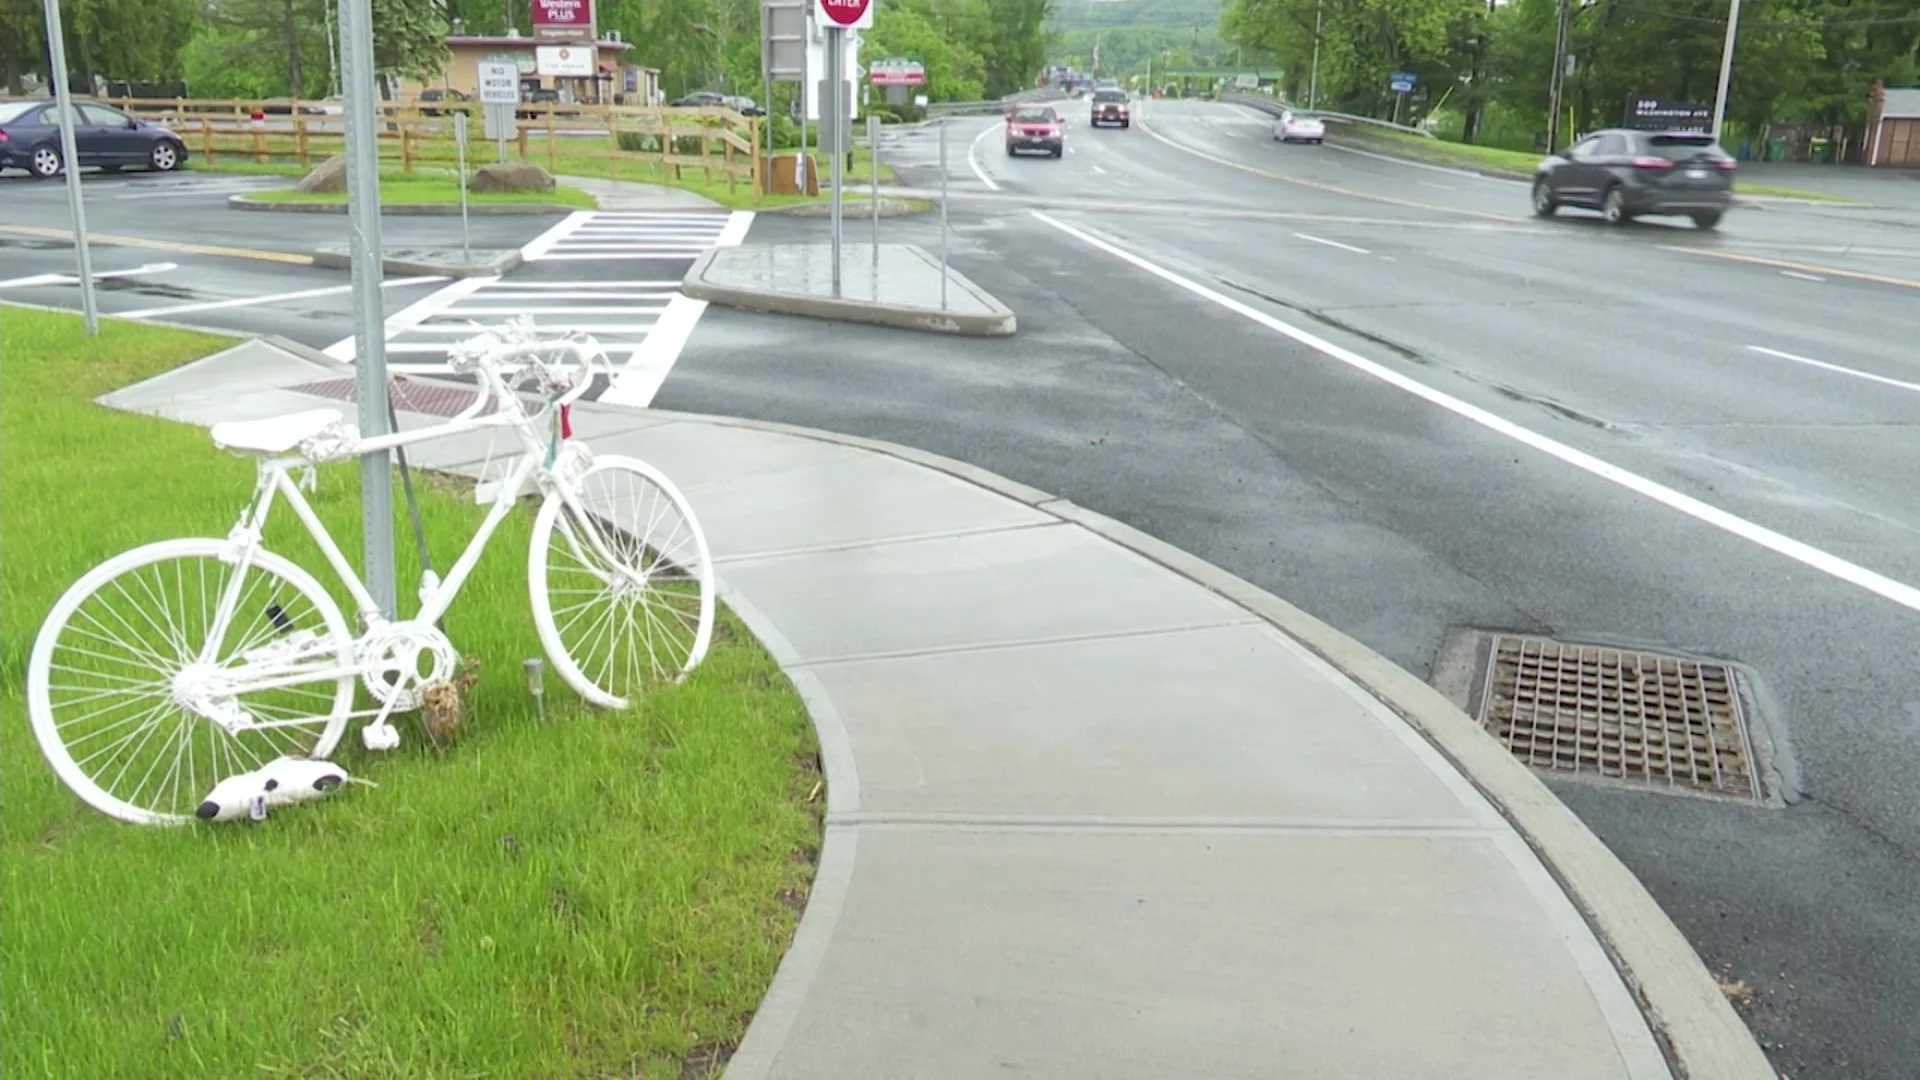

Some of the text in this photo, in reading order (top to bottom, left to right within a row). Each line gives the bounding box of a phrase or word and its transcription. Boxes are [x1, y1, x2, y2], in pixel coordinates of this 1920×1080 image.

[547, 9, 576, 20] PLUS
[491, 67, 505, 75] NO
[485, 79, 512, 87] MOTOR
[483, 91, 516, 99] VEHICLES
